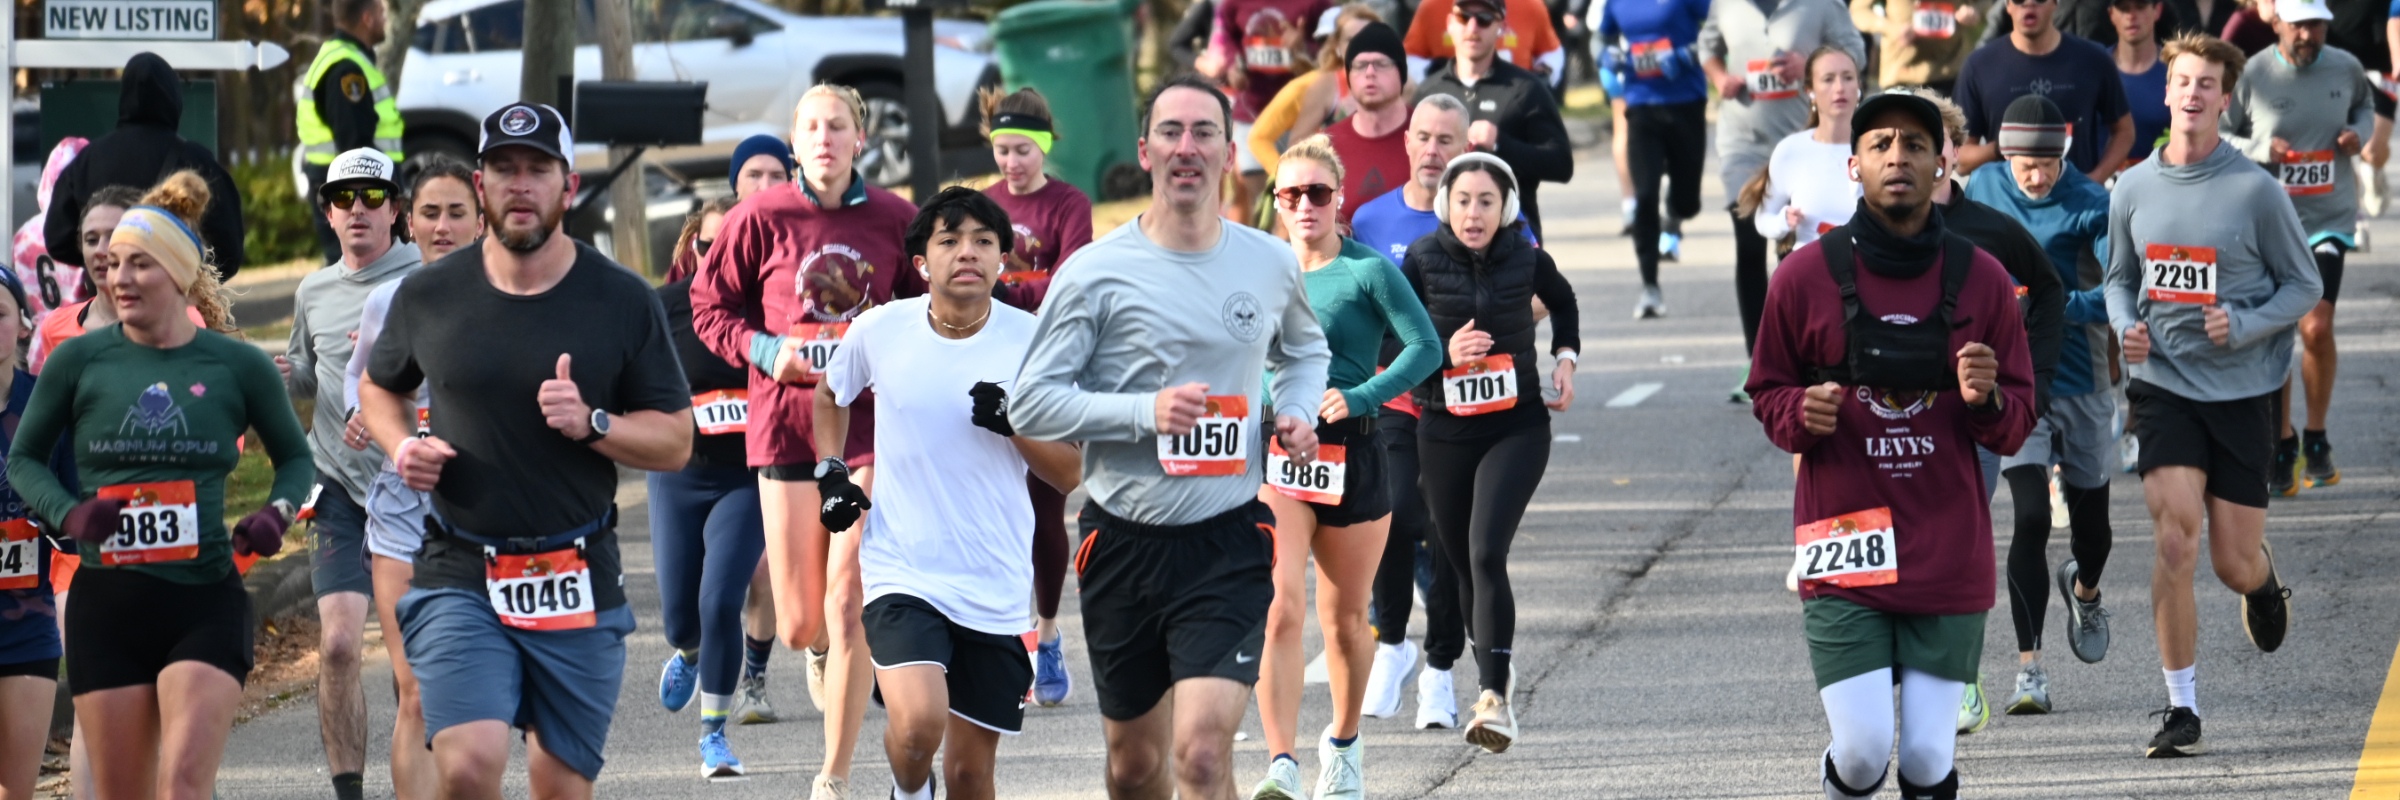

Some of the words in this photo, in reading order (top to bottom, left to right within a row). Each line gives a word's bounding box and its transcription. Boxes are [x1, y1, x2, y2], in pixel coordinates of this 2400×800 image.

[50, 6, 108, 31] NEW
[115, 7, 209, 32] LISTING
[2284, 163, 2330, 185] 2269
[36, 254, 61, 310] 6
[2154, 263, 2209, 291] 2291
[1454, 374, 1506, 404] 1701
[88, 439, 168, 454] MAGNUM
[171, 440, 219, 455] OPUS
[1865, 435, 1935, 457] LEVYS
[1280, 460, 1331, 490] 986
[117, 509, 180, 548] 983
[1805, 533, 1886, 576] 2248
[498, 575, 582, 615] 1046
